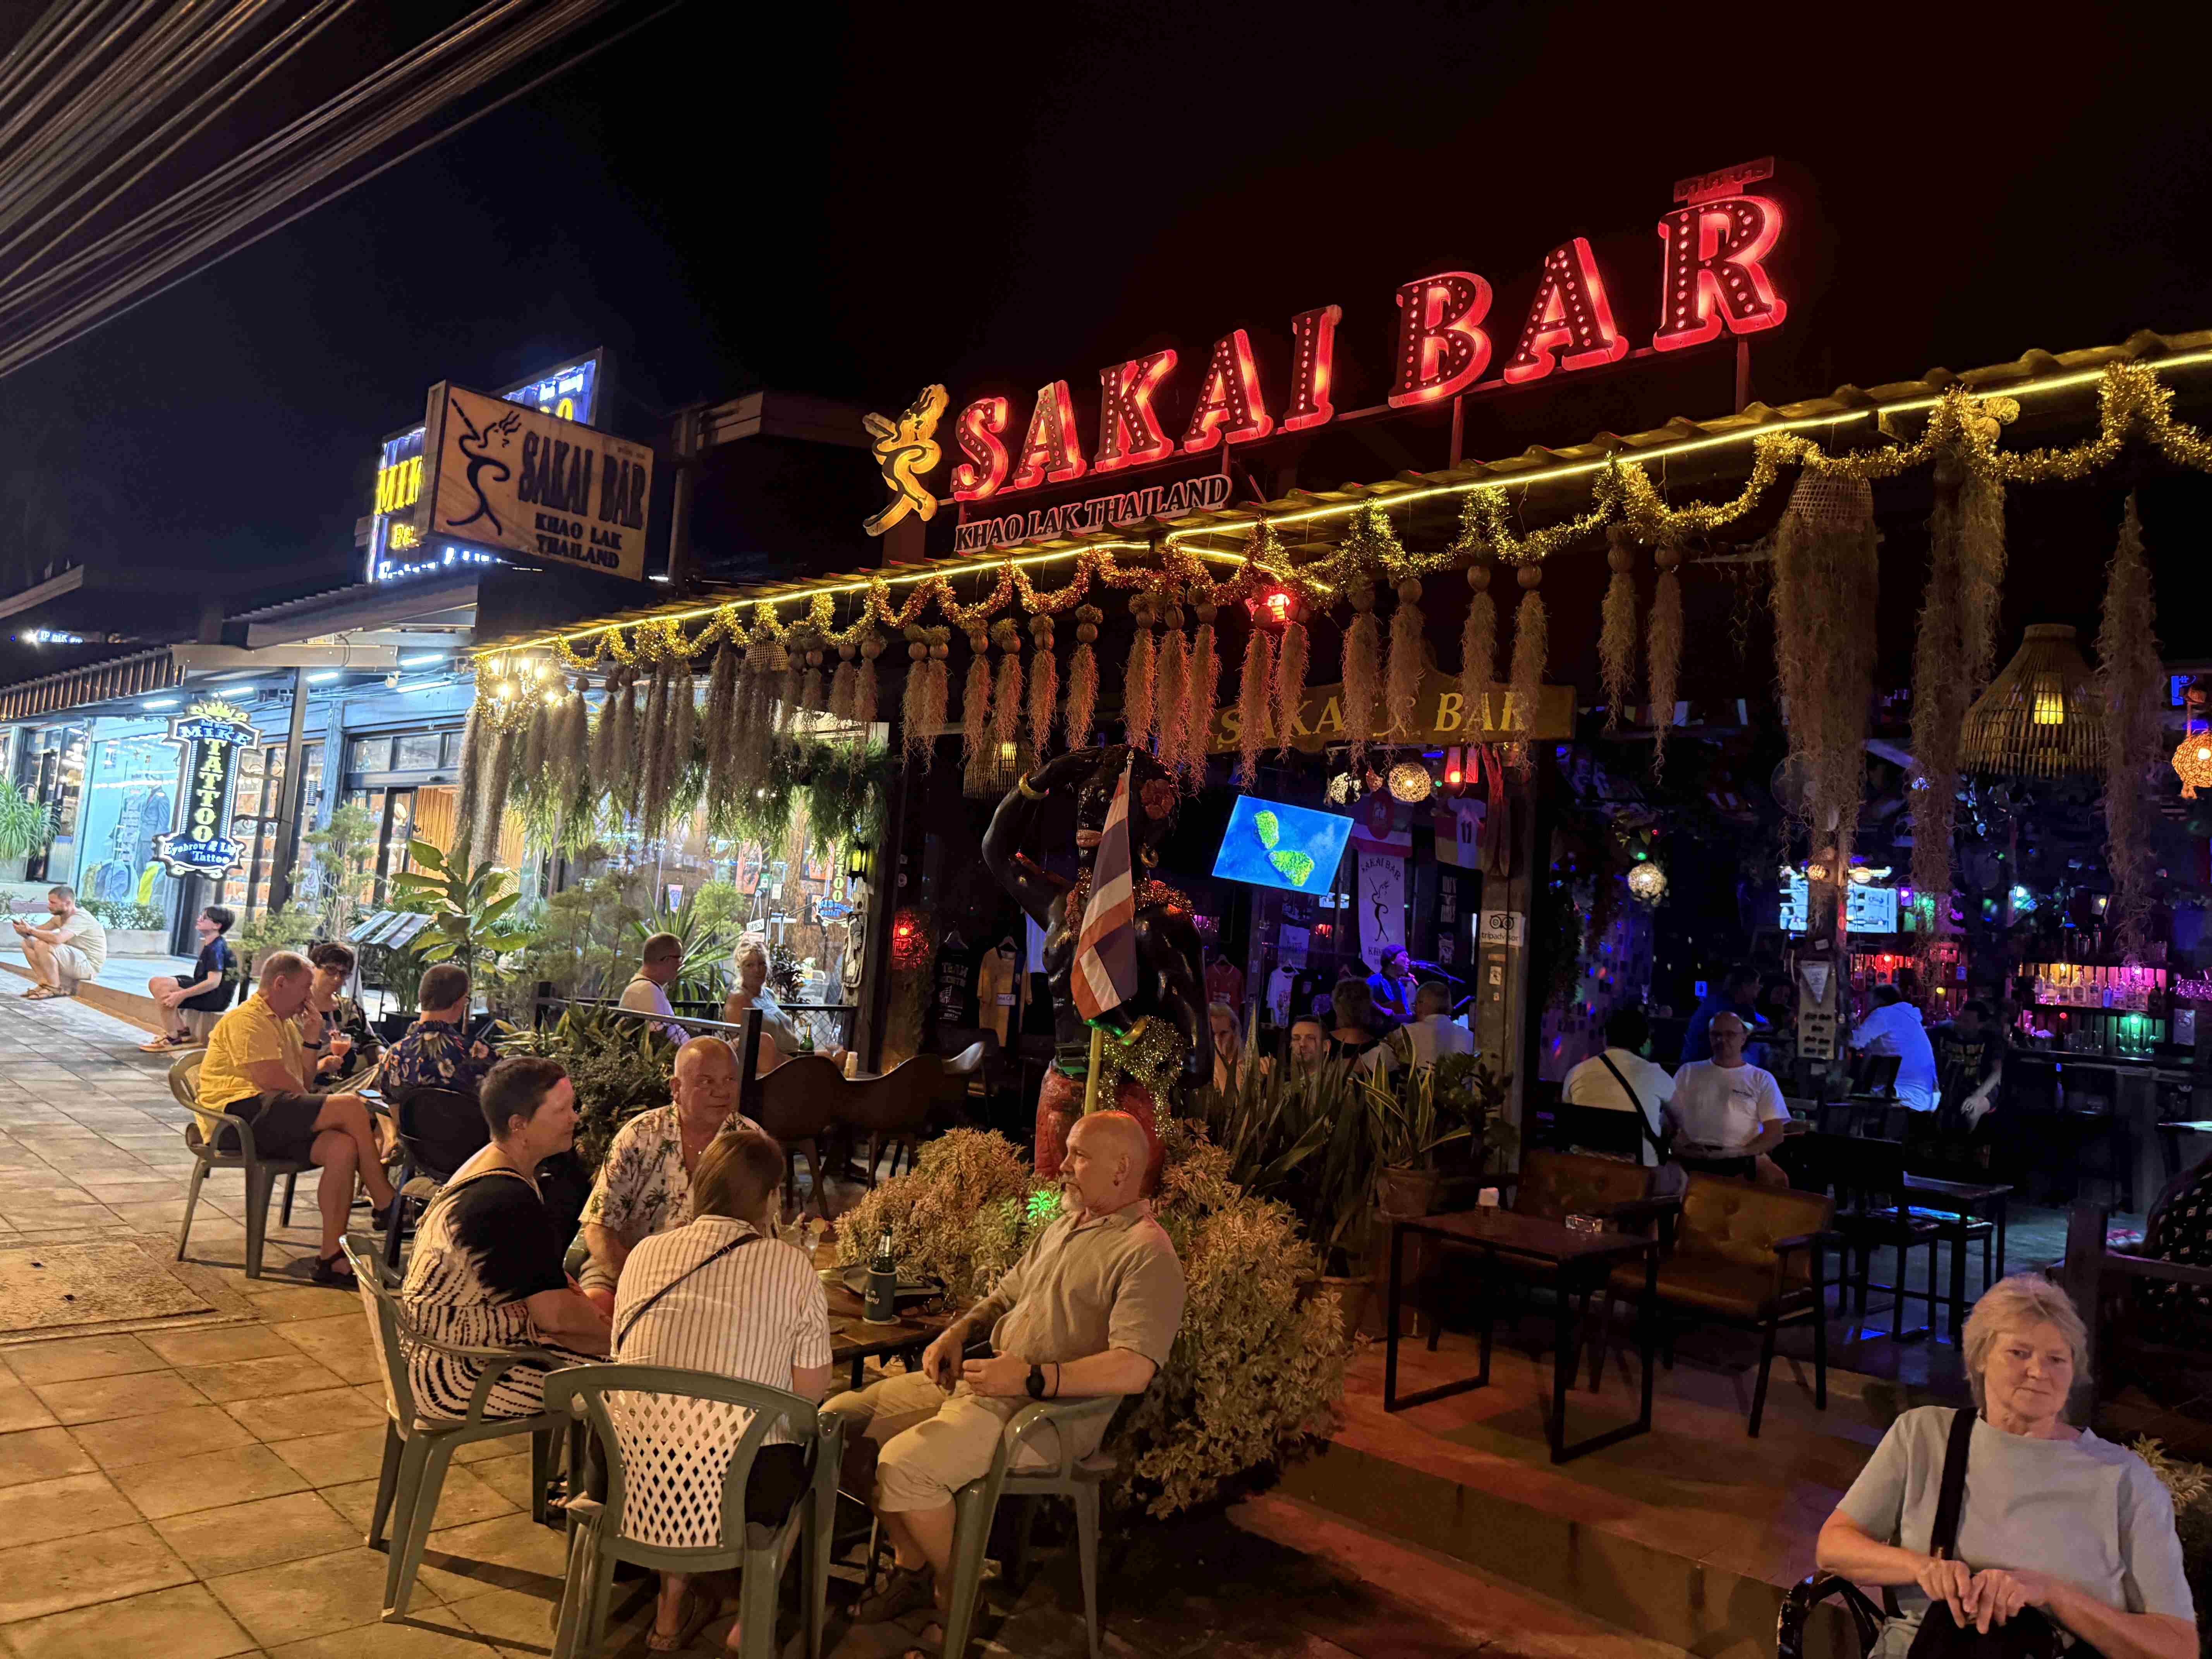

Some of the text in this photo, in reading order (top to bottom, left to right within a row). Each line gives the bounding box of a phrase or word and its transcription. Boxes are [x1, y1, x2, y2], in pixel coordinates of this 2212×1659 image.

[952, 194, 1788, 501] SAKAI BAR
[518, 430, 646, 531] SAKAI BAR
[954, 474, 1233, 553] KHAO LAK THAILAND
[535, 512, 622, 551] KHAO LAK
[536, 534, 620, 569] THAILAND
[179, 726, 252, 746] MIKE
[191, 738, 228, 843] TATTOO
[164, 843, 206, 855] Eyebrow
[192, 851, 230, 864] Tattoo
[748, 921, 763, 931] OPEN
[1481, 931, 1520, 942] tripadvsor
